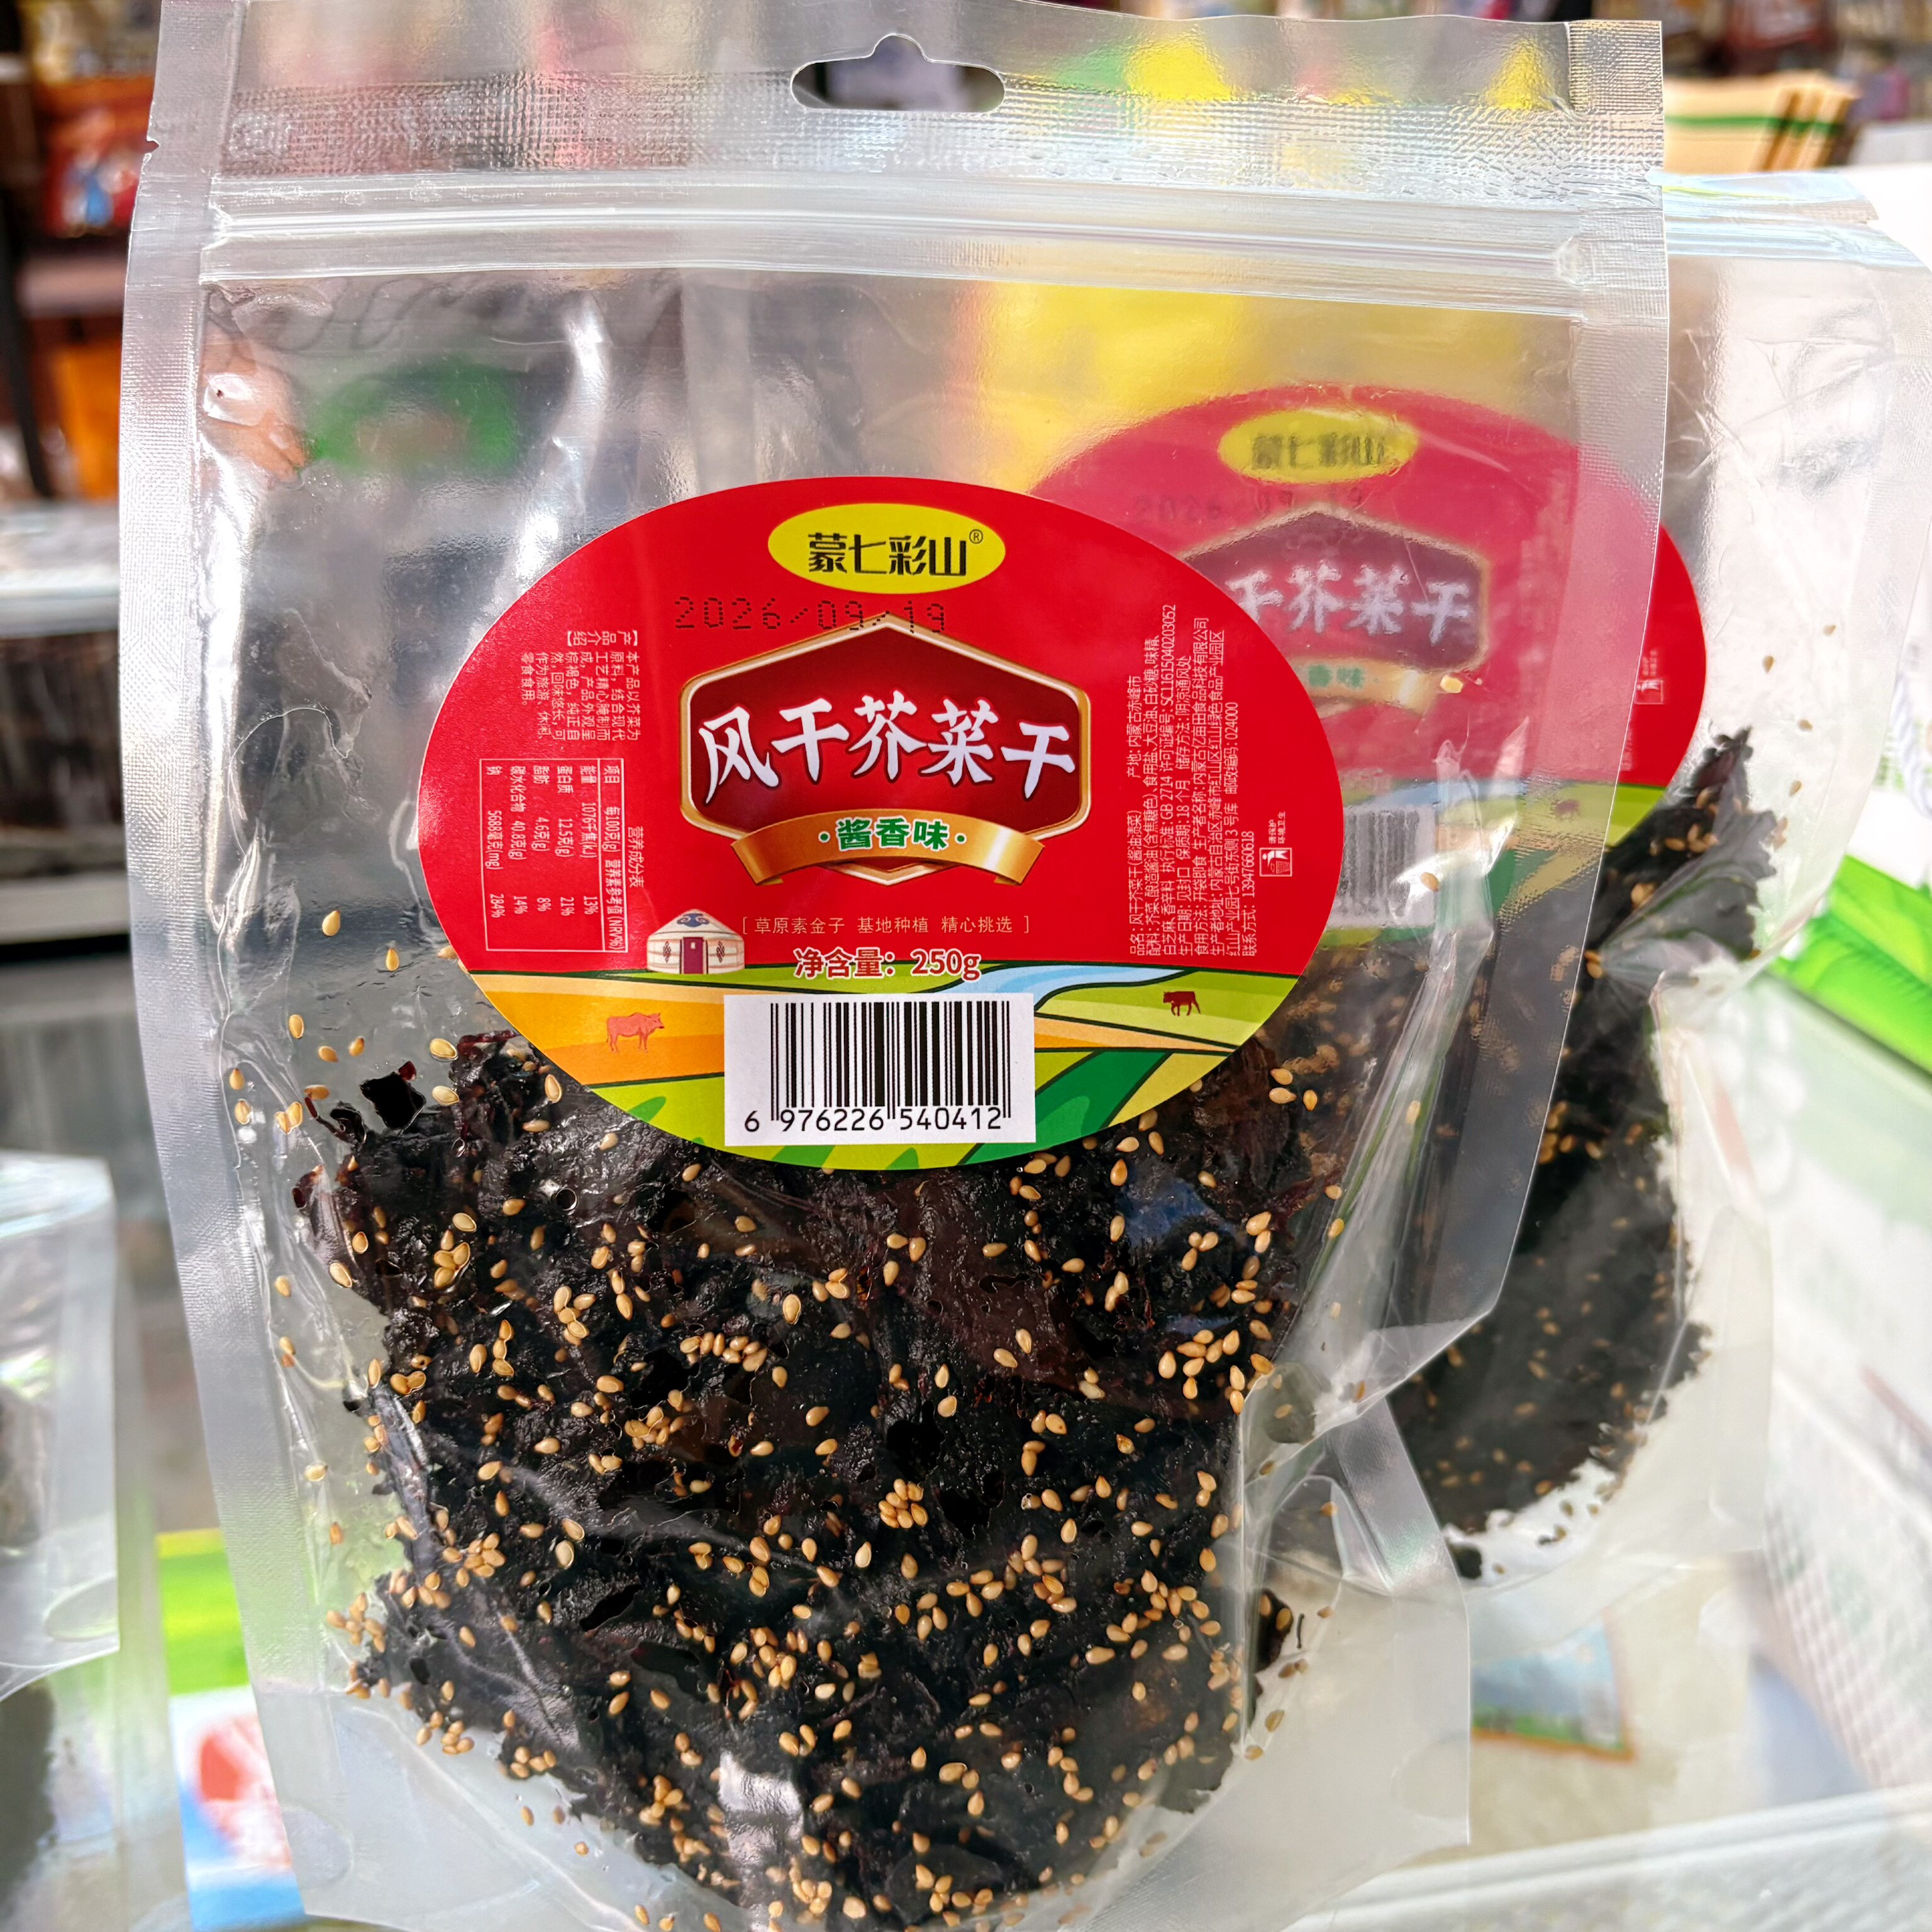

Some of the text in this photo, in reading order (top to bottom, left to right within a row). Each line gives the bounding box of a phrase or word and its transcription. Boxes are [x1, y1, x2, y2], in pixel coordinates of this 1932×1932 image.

[674, 595, 947, 635] 2026/09/19
[1225, 560, 1472, 646] 干芥菜干
[566, 652, 580, 740] 棕褐色，纯正自
[580, 652, 595, 740] 成，产品外观呈
[596, 652, 611, 740] 工艺精心腌制而
[610, 652, 625, 741] 原料，结合现代
[626, 652, 640, 740] 本产品以芥菜为
[698, 689, 1076, 805] 风干芥菜干
[486, 766, 502, 775] 钠
[533, 765, 550, 784] 脂肪
[557, 765, 574, 794] 蛋白质
[580, 765, 597, 784] 能量
[604, 765, 620, 783] 项目
[510, 766, 526, 811] 碳水化合物
[628, 826, 644, 888] 营养成分表
[490, 894, 504, 918] 284%
[514, 896, 528, 914] 14%
[537, 897, 551, 911] 8%
[560, 897, 574, 916] 21%
[584, 896, 598, 914] 13%
[857, 916, 930, 935] 基地种植
